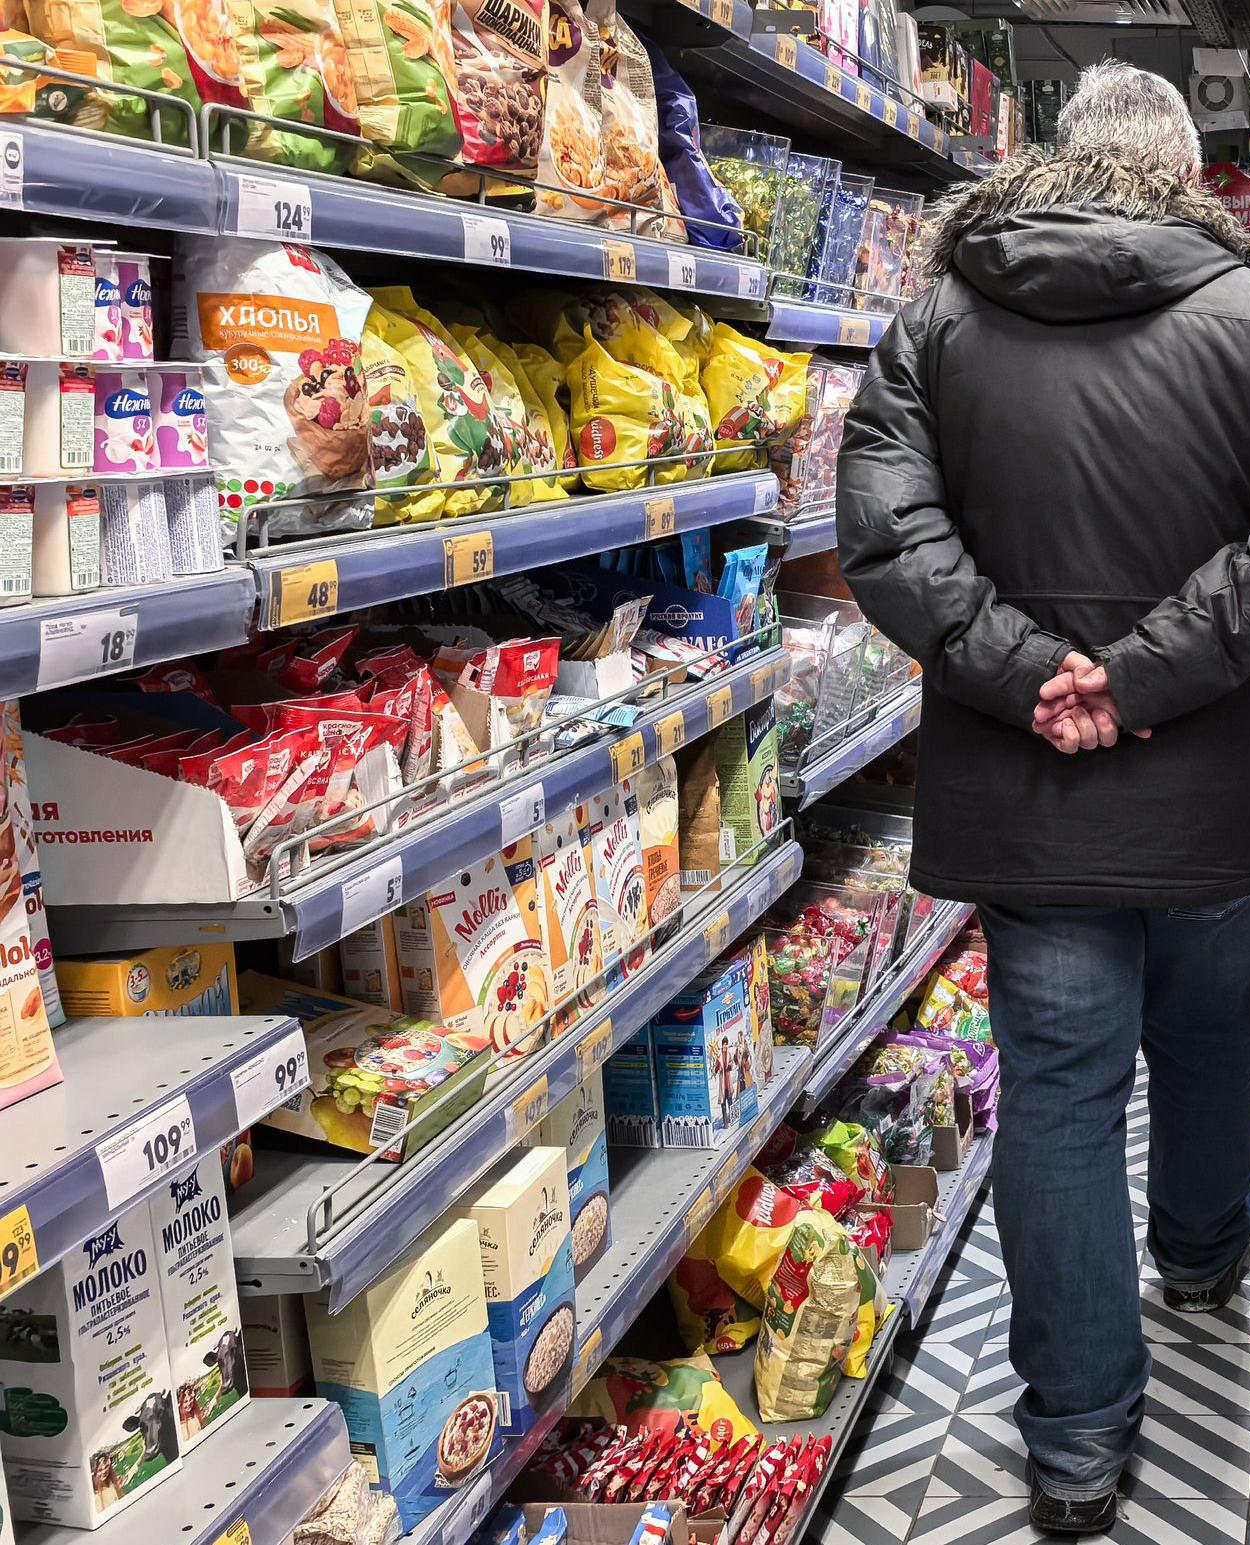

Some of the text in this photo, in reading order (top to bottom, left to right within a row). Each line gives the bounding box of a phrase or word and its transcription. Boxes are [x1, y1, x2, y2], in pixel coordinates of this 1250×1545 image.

[273, 201, 304, 231] 124
[490, 235, 505, 258] 99
[219, 306, 321, 334] ХЛОПЬЯ
[473, 549, 488, 573] 59
[307, 582, 329, 609] 48
[101, 630, 125, 664] 18
[34, 828, 154, 844] готовления
[386, 883, 395, 904] 5
[454, 886, 508, 944] Mollis
[275, 1056, 297, 1092] 99
[143, 1117, 191, 1172] 109 99
[161, 1195, 221, 1254] МОЛОКО
[72, 1248, 147, 1313] МОЛОКО
[90, 1285, 132, 1317] ПИТЬЕВОЕ
[106, 1324, 131, 1346] 2,5%
